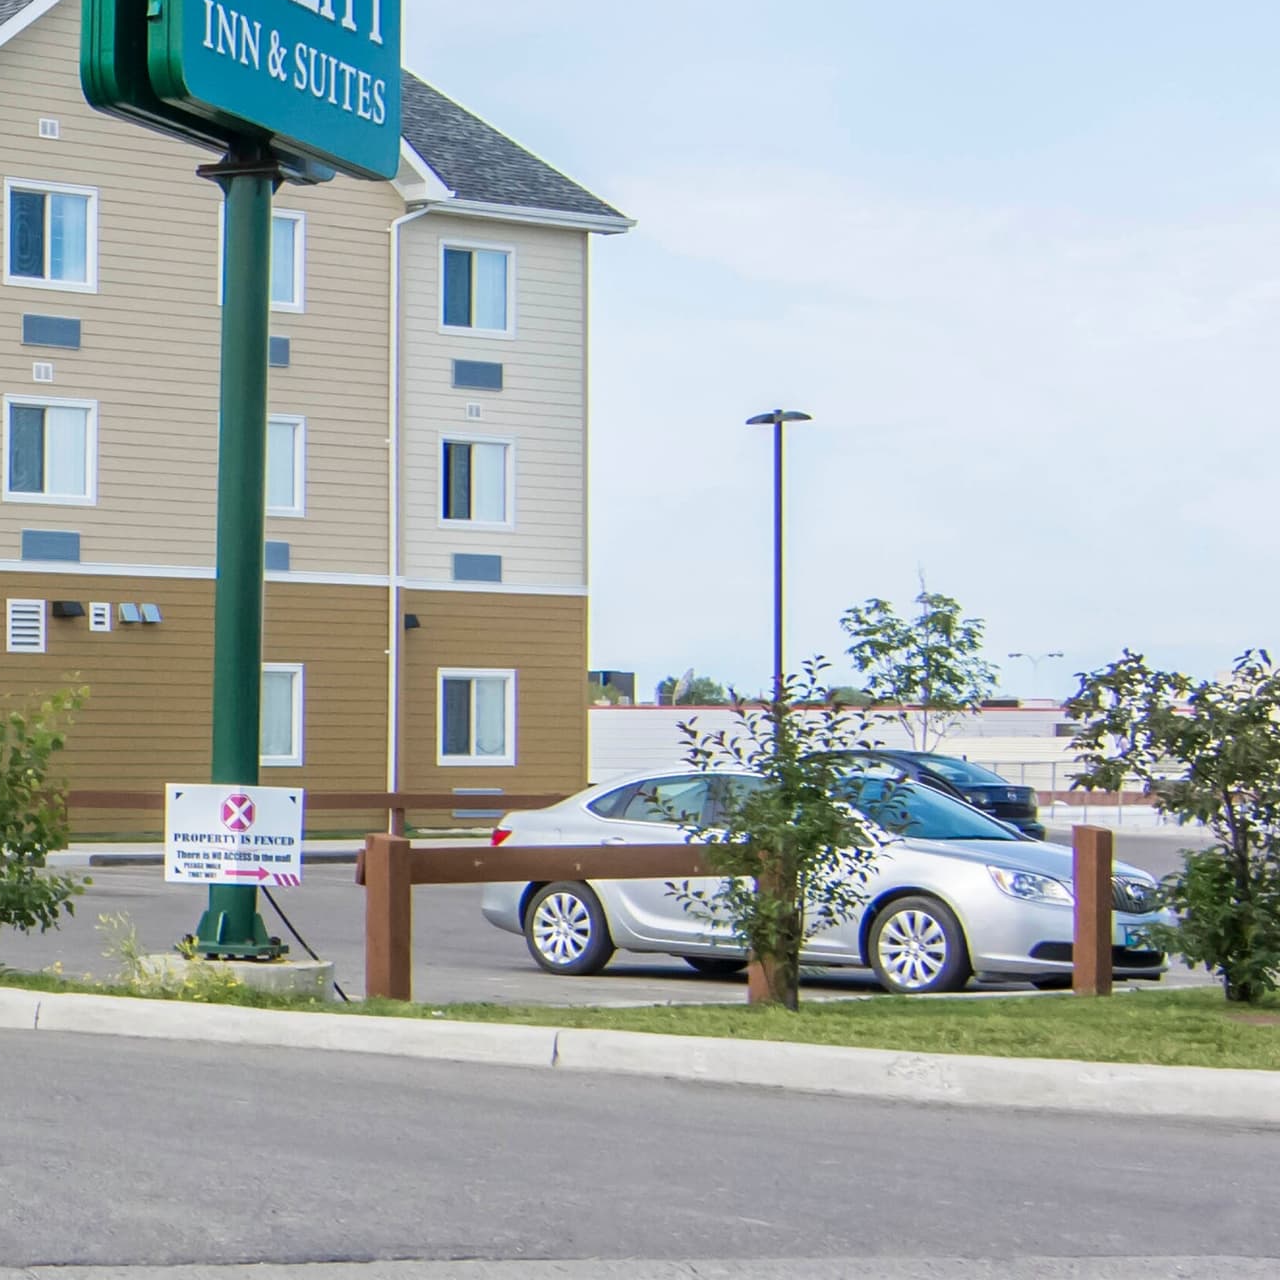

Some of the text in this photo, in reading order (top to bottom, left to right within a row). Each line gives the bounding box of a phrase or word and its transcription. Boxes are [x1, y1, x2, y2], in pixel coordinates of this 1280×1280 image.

[268, 29, 288, 82] &
[294, 42, 386, 125] SUITES
[173, 832, 295, 846] PROPERTY IS FENCED
[176, 849, 201, 860] There
[202, 851, 210, 860] is
[211, 851, 222, 861] NO
[223, 851, 252, 862] ACCESS
[253, 853, 260, 862] to
[261, 853, 274, 862] the
